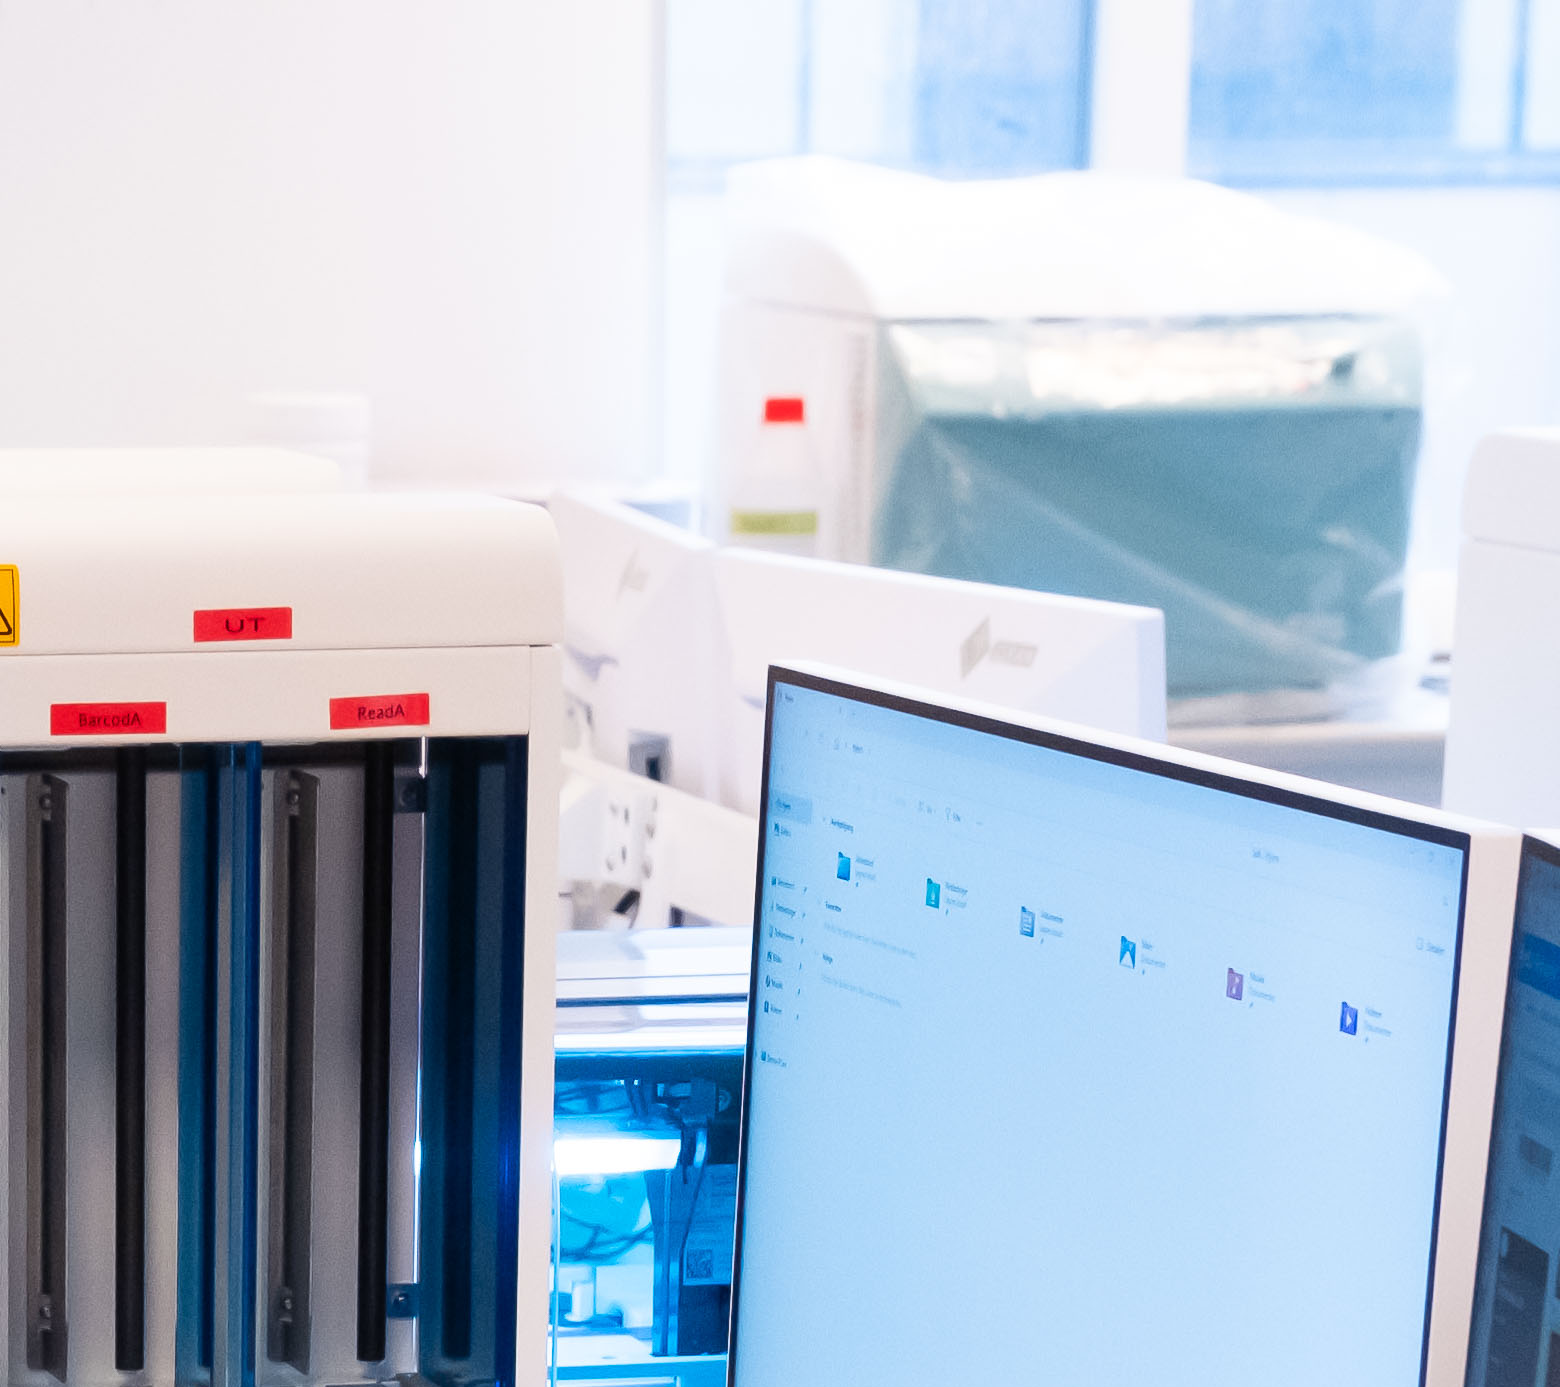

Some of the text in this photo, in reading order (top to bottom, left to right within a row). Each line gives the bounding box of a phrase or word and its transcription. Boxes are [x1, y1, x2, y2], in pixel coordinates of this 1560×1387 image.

[225, 616, 266, 633] UT
[79, 711, 143, 728] BarcodA
[357, 703, 406, 721] ReadA
